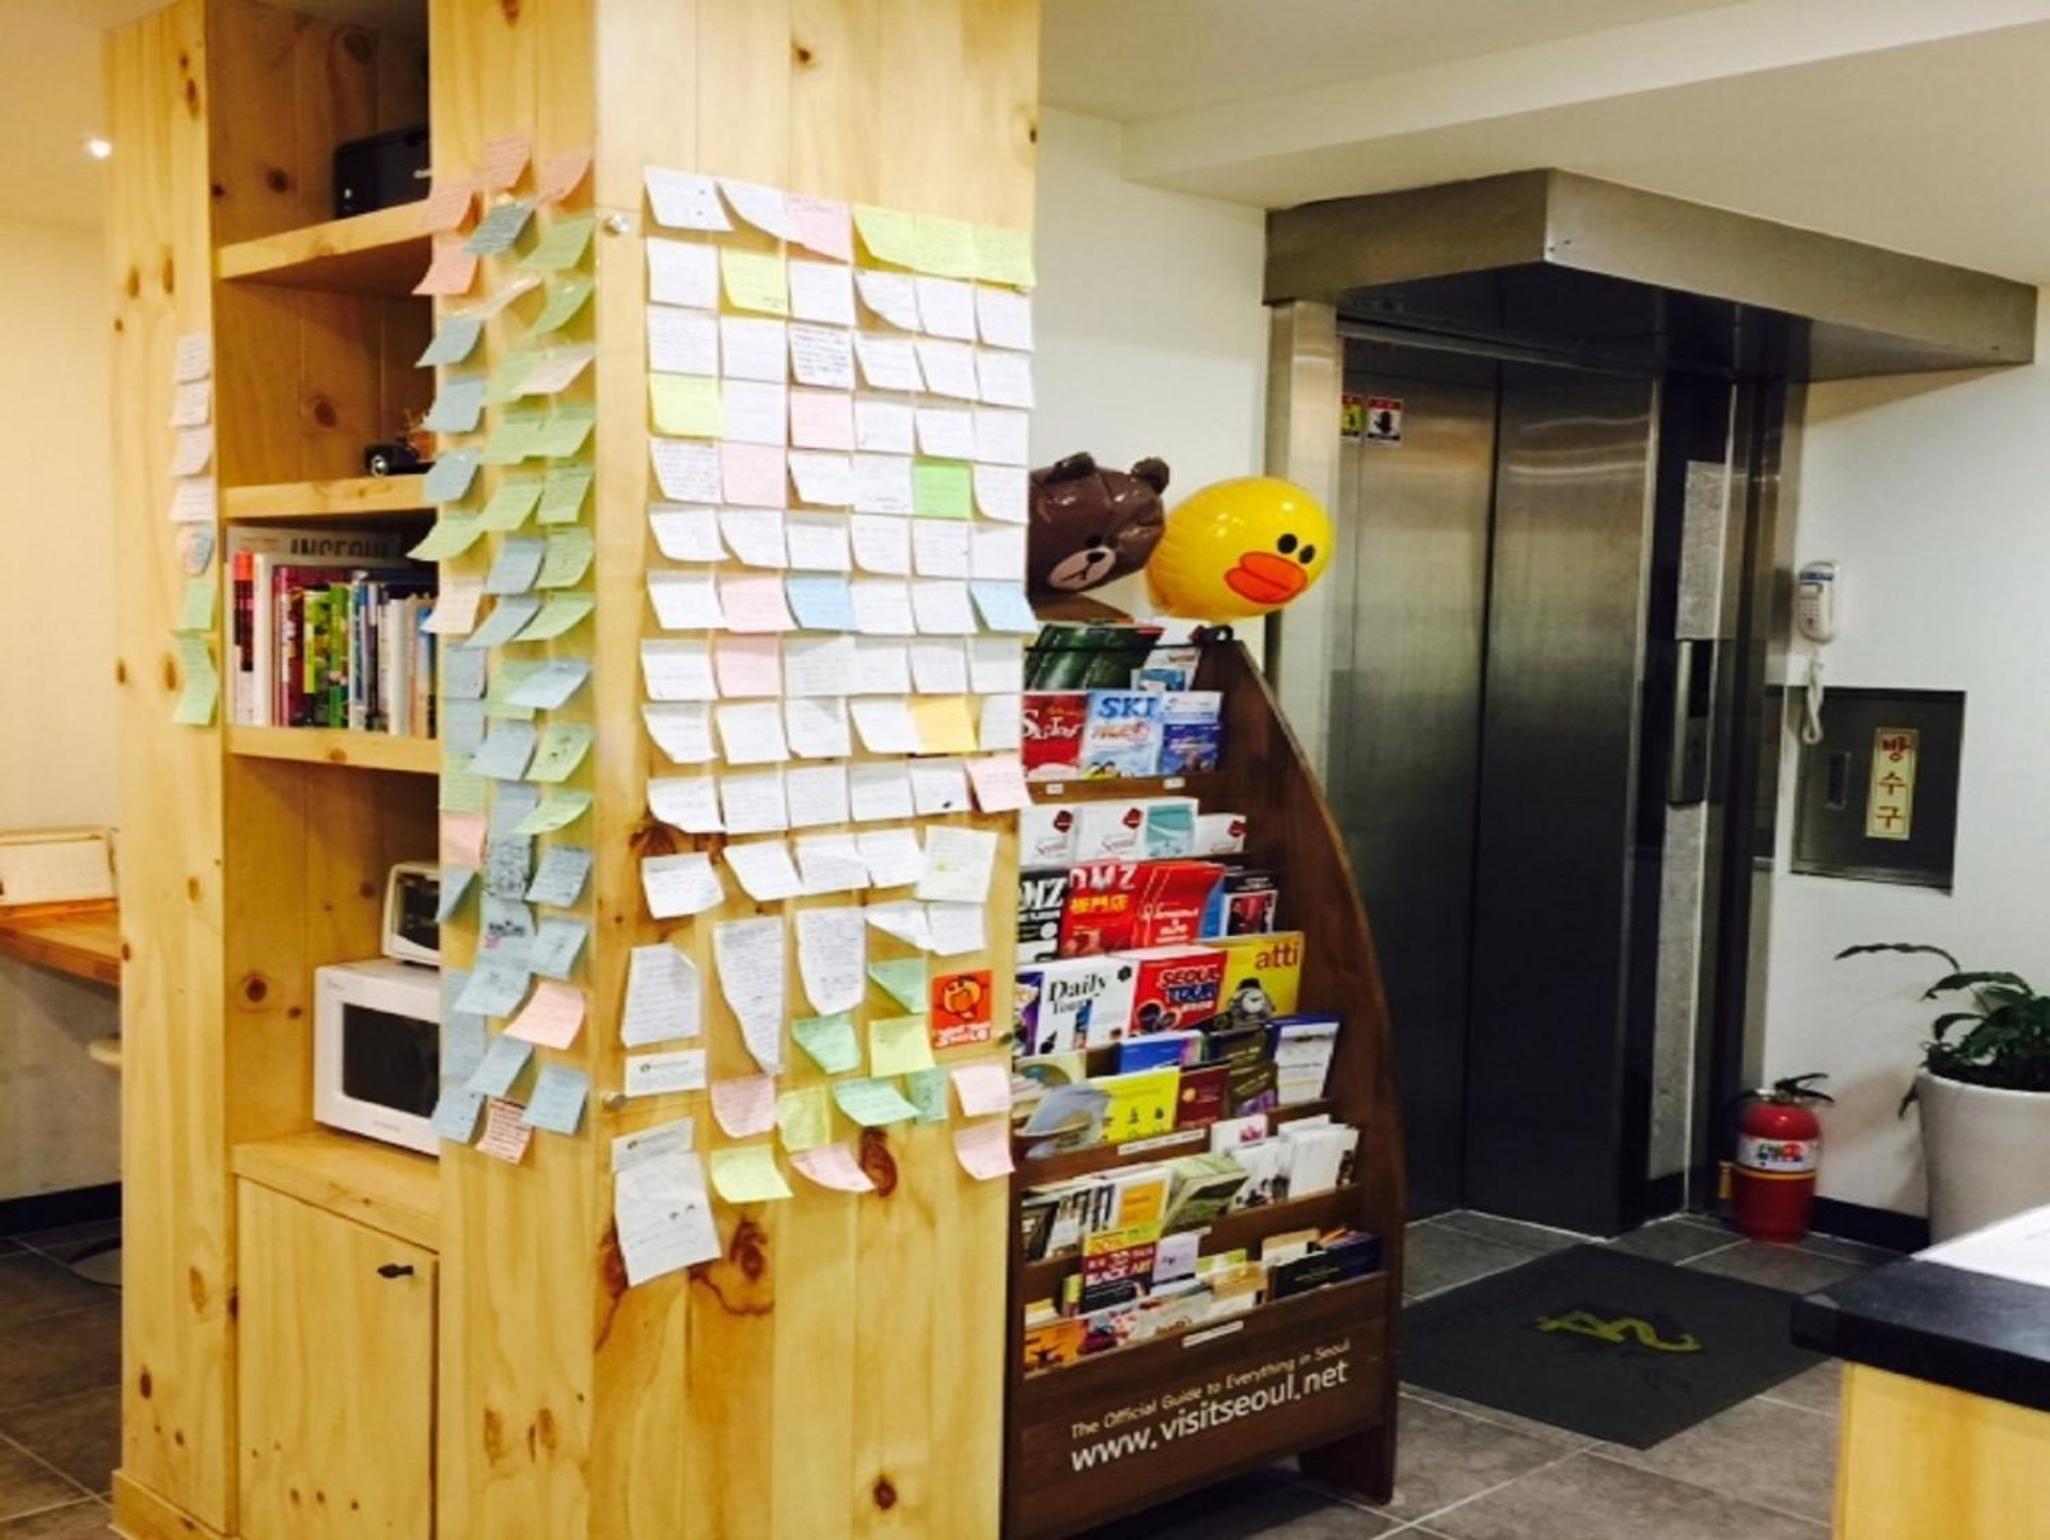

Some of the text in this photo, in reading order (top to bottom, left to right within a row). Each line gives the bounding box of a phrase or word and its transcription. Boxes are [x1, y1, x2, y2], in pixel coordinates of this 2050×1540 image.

[1099, 697, 1159, 719] SKI
[1877, 737, 1912, 830] 방수구
[1019, 877, 1068, 911] MZ
[1256, 938, 1300, 970] atti
[1048, 974, 1106, 1001] Daily
[1072, 1422, 1098, 1438] The
[1104, 1400, 1157, 1428] Official
[1162, 1387, 1201, 1410] Guide
[1207, 1382, 1222, 1395] to
[1226, 1358, 1295, 1389] Everything
[1315, 1338, 1350, 1361] Seoul
[1071, 1360, 1349, 1472] www.visitseoul.net
